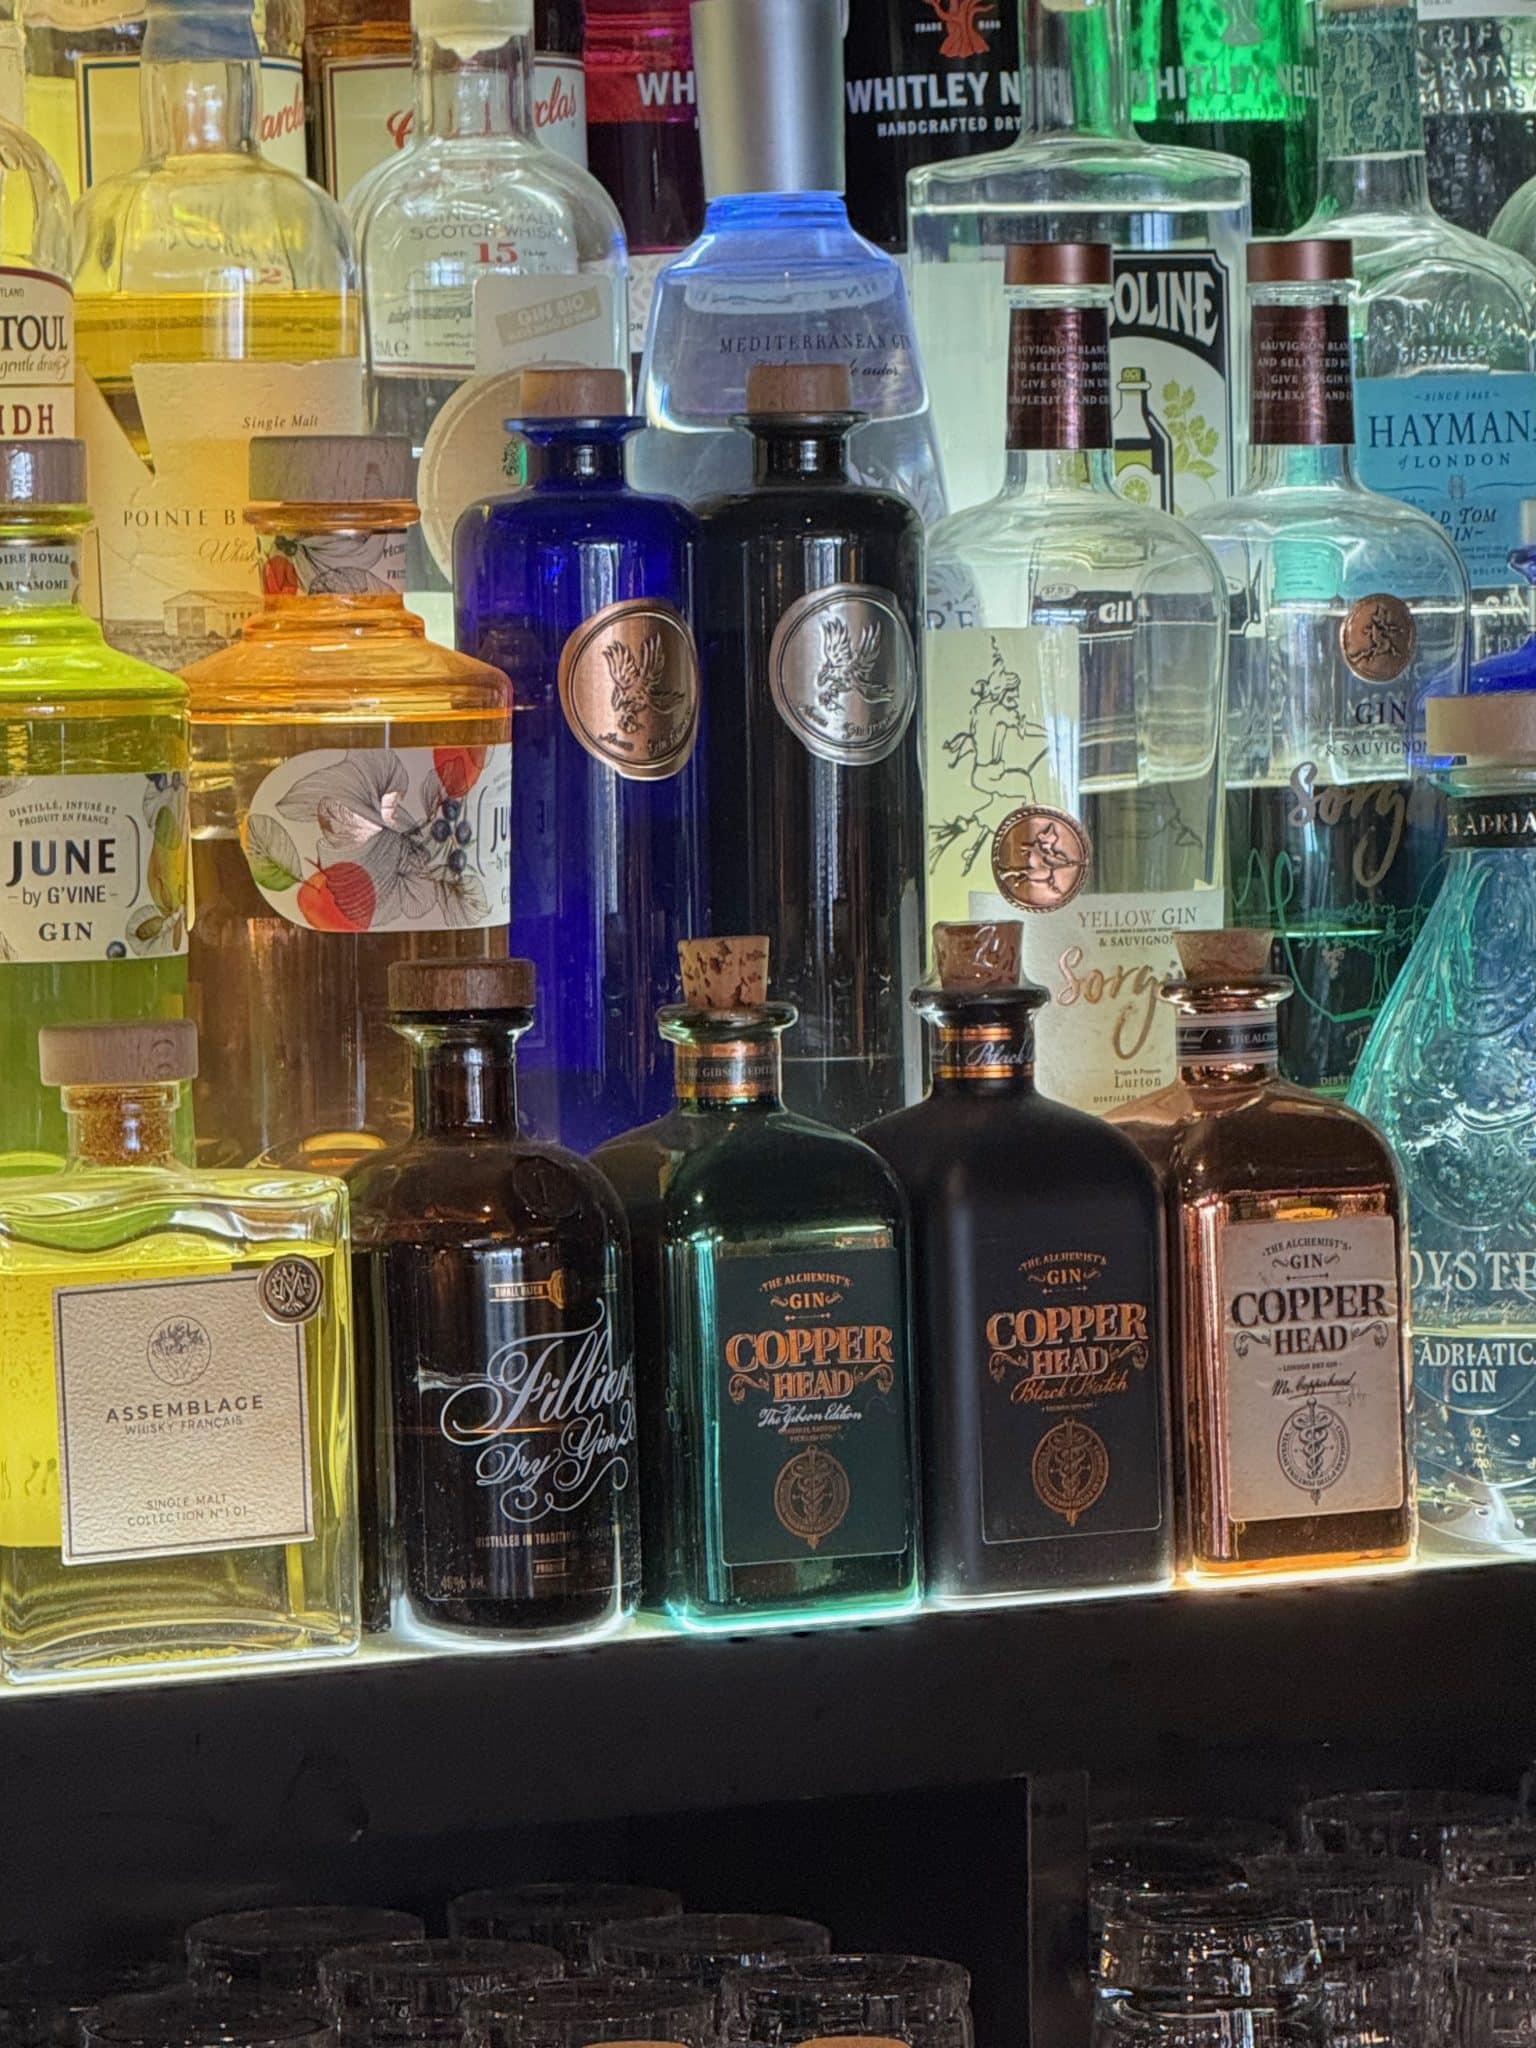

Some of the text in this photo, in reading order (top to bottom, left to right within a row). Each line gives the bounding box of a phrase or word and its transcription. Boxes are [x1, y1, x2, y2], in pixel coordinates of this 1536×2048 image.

[845, 71, 989, 115] WHITLEY
[877, 117, 988, 138] HANDCRAFTED
[473, 241, 519, 265] 15
[719, 333, 887, 354] MEDITERRANEAN
[242, 415, 287, 432] Single
[1368, 409, 1536, 449] HAYMAN
[1414, 452, 1511, 469] LONDON
[123, 508, 208, 528] POINTE
[1355, 700, 1409, 726] GIN
[5, 837, 117, 888] JUNE
[22, 886, 42, 909] by
[1077, 906, 1200, 929] YELLOW GIN
[38, 920, 94, 942] GIN
[1113, 1075, 1162, 1090] Lurton
[1264, 1242, 1285, 1256] THE
[1289, 1253, 1324, 1270] GIN
[761, 1276, 782, 1293] THE
[1046, 1267, 1083, 1286] GIN
[788, 1291, 826, 1310] GIN
[1230, 1283, 1391, 1329] COPPER
[985, 1302, 1149, 1351] COPPER
[725, 1324, 895, 1373] COPPER
[1273, 1324, 1350, 1357] HEAD
[1031, 1345, 1110, 1379] HEAD
[1418, 1342, 1535, 1368] ADRIATIC
[772, 1368, 855, 1403] HEAD
[1451, 1368, 1498, 1393] GIN
[105, 1394, 264, 1424] ASSEMBLAGE
[757, 1407, 782, 1428] The
[475, 1439, 562, 1493] Dry
[146, 1492, 227, 1512] SINGLE MALT
[126, 1509, 205, 1528] COLLECTION
